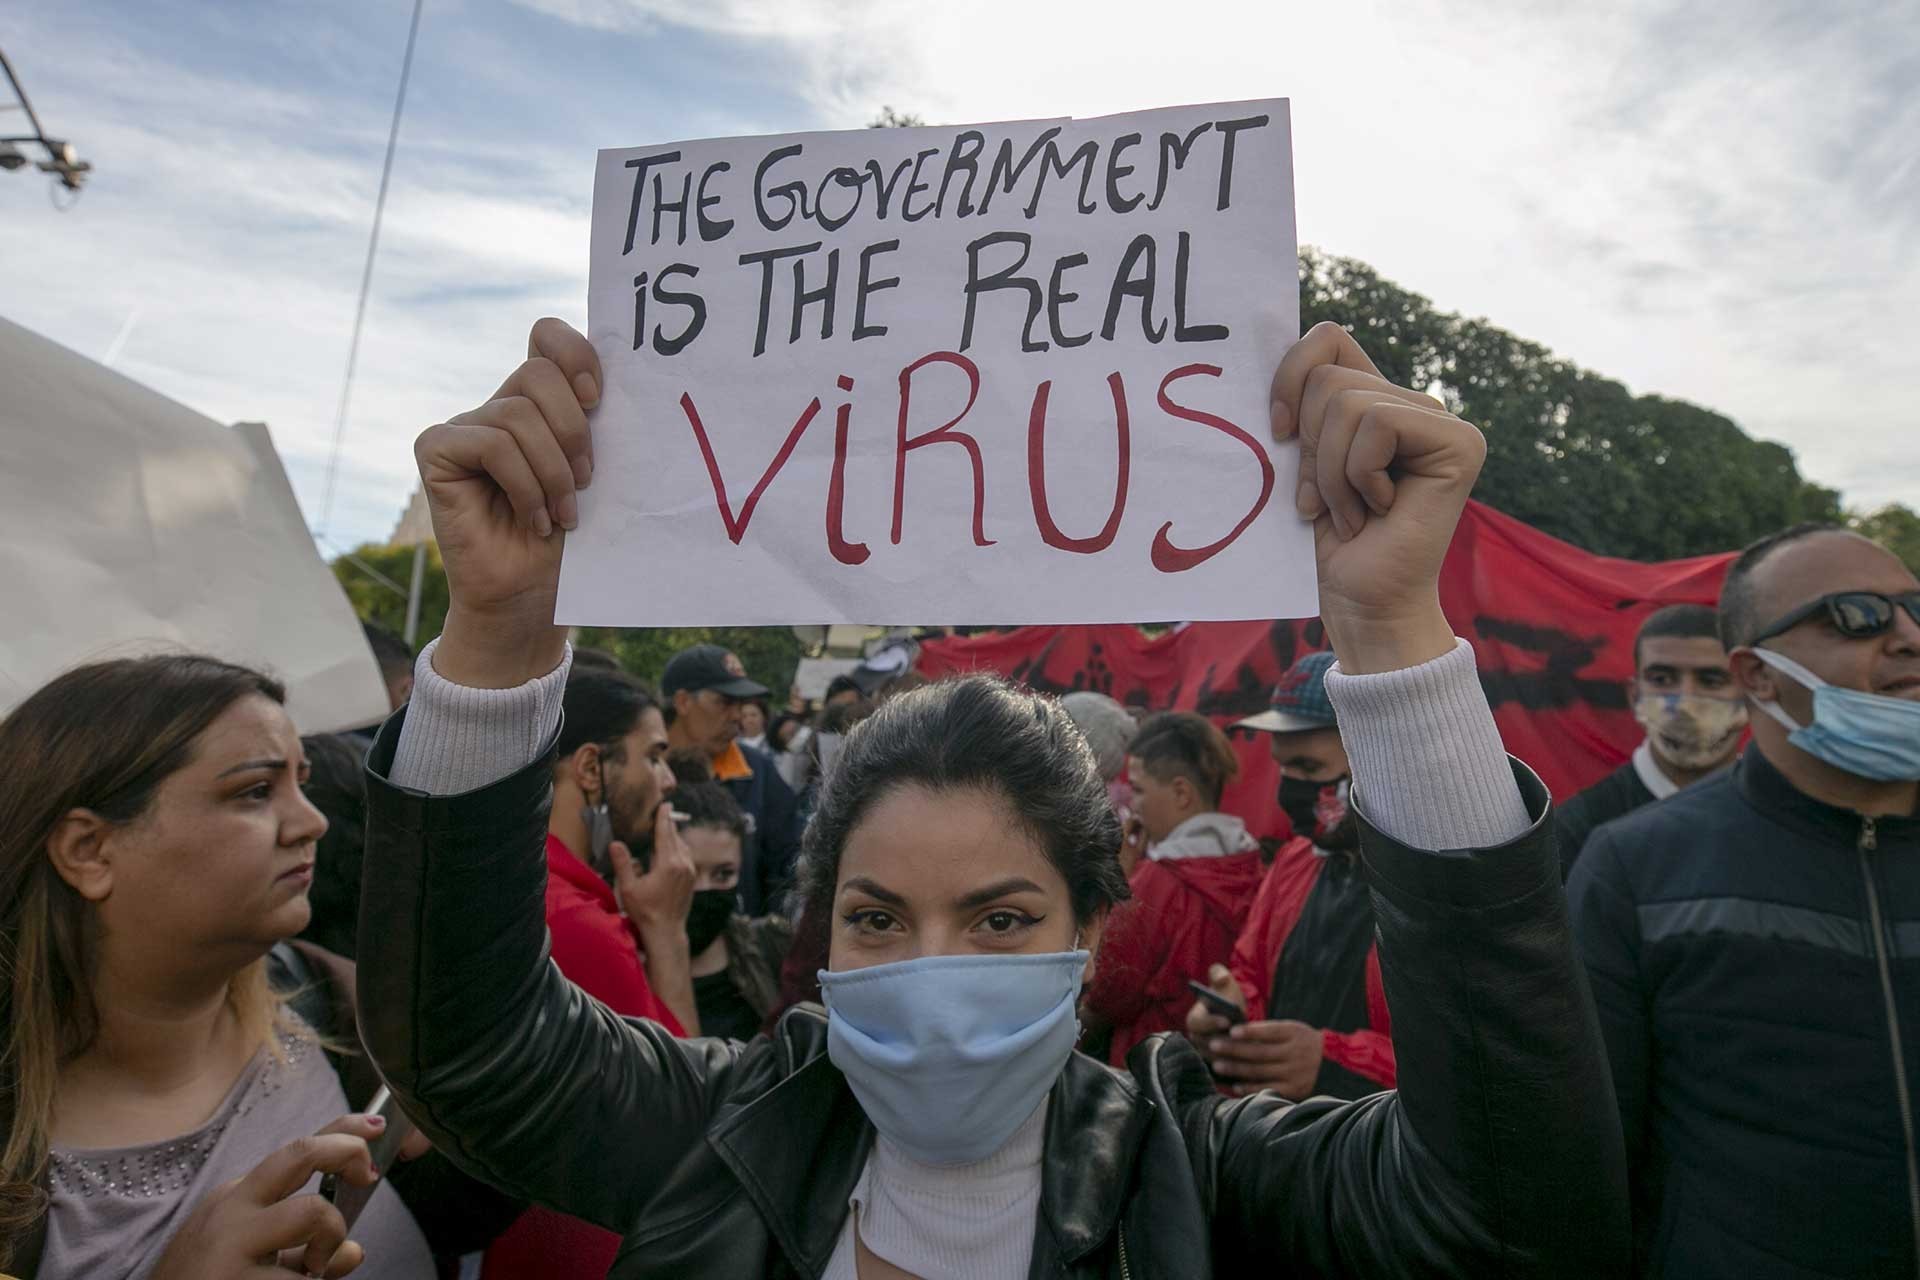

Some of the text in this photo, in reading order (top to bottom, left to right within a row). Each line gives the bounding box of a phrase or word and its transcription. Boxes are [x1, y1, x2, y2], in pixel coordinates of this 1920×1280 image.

[622, 114, 1270, 257] THE GOVERNMENT
[738, 238, 901, 358] THE
[958, 231, 1230, 354] REAL
